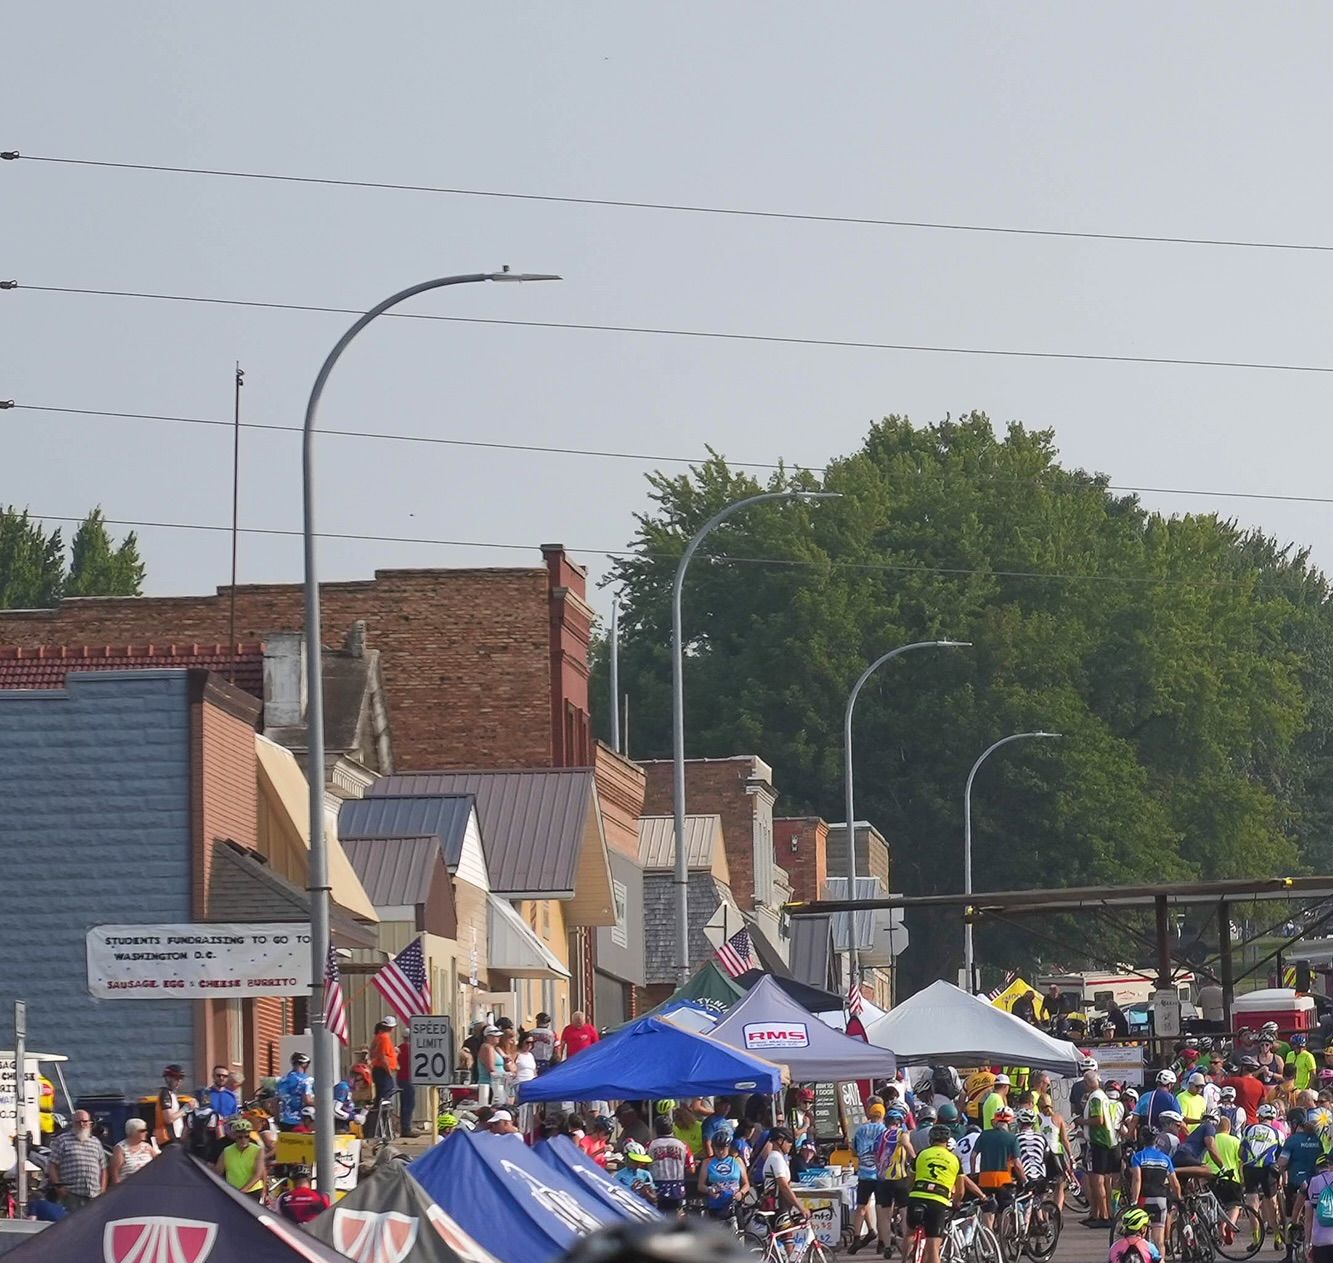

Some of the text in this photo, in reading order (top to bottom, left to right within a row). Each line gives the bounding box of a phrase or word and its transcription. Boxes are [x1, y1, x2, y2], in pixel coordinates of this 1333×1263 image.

[105, 936, 161, 945] STUDENTS
[167, 936, 244, 945] FUNDRAISING
[252, 936, 267, 944] TO
[297, 935, 313, 943] TO
[114, 951, 188, 960] WASHINGTON
[163, 979, 185, 988] EGG
[198, 979, 242, 988] CHEESE
[247, 977, 298, 987] BURRITO
[412, 1023, 448, 1034] SPEED
[749, 1032, 806, 1041] RMS
[415, 1038, 444, 1050] LIMIT
[414, 1052, 447, 1078] 20
